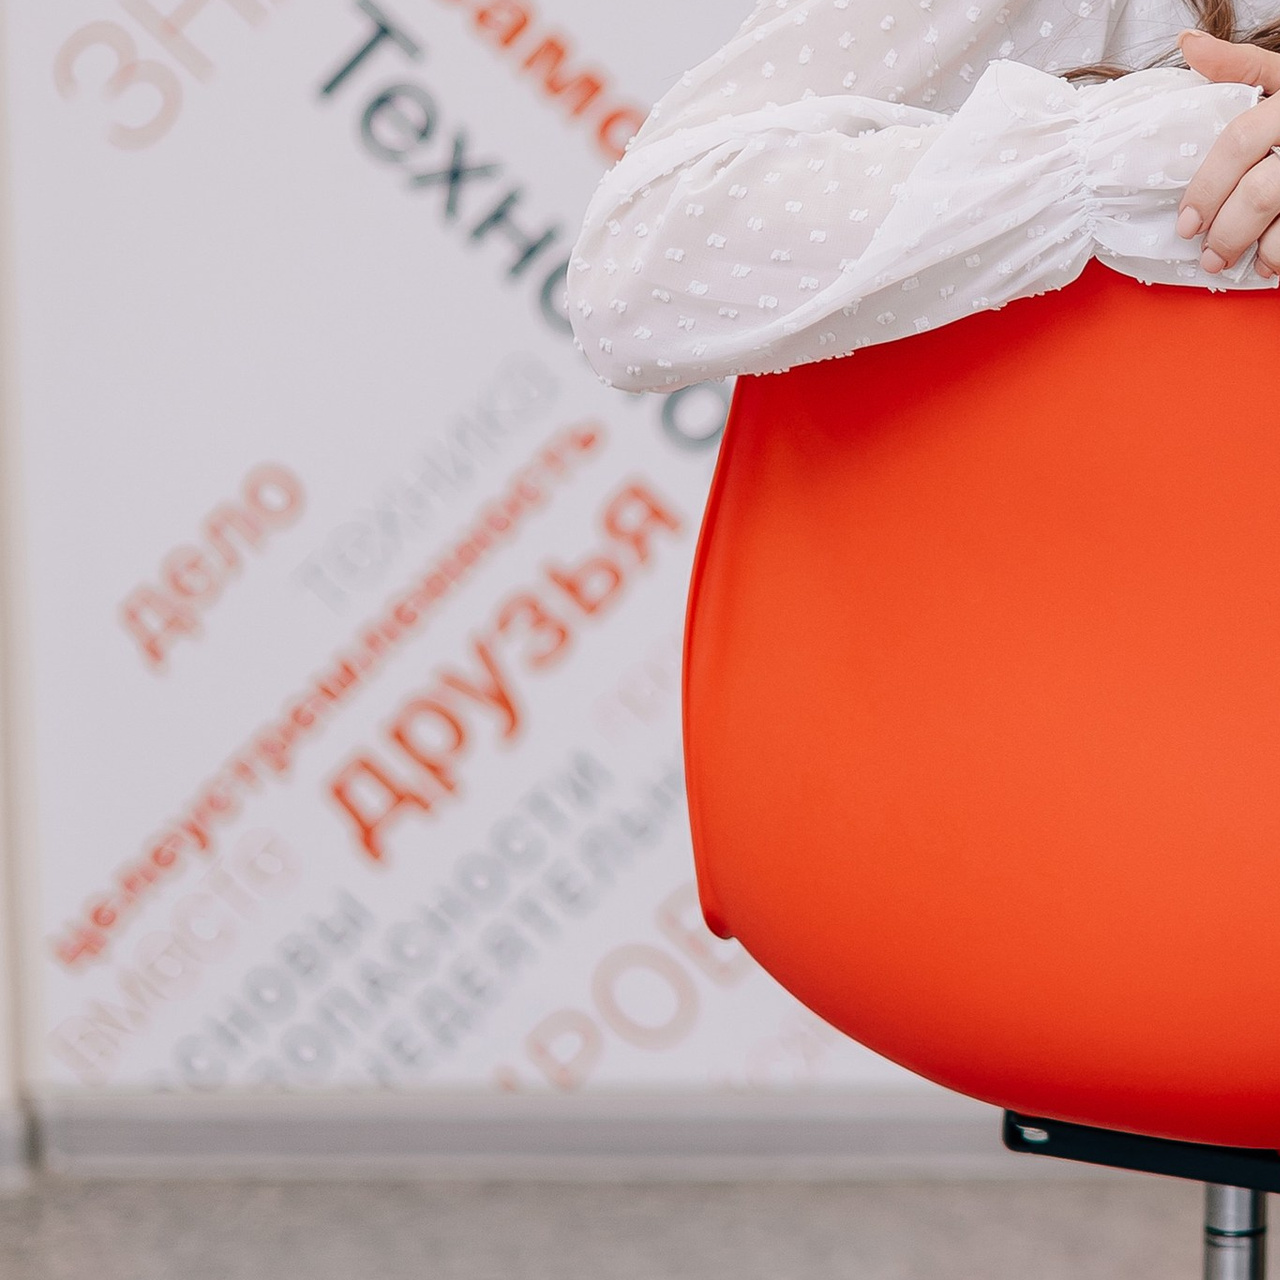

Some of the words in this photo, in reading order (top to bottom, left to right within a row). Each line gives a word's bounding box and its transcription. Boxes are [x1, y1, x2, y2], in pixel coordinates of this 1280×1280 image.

[118, 462, 306, 677] дело
[325, 477, 686, 868] друзья
[155, 888, 376, 1090] СНОВЫ
